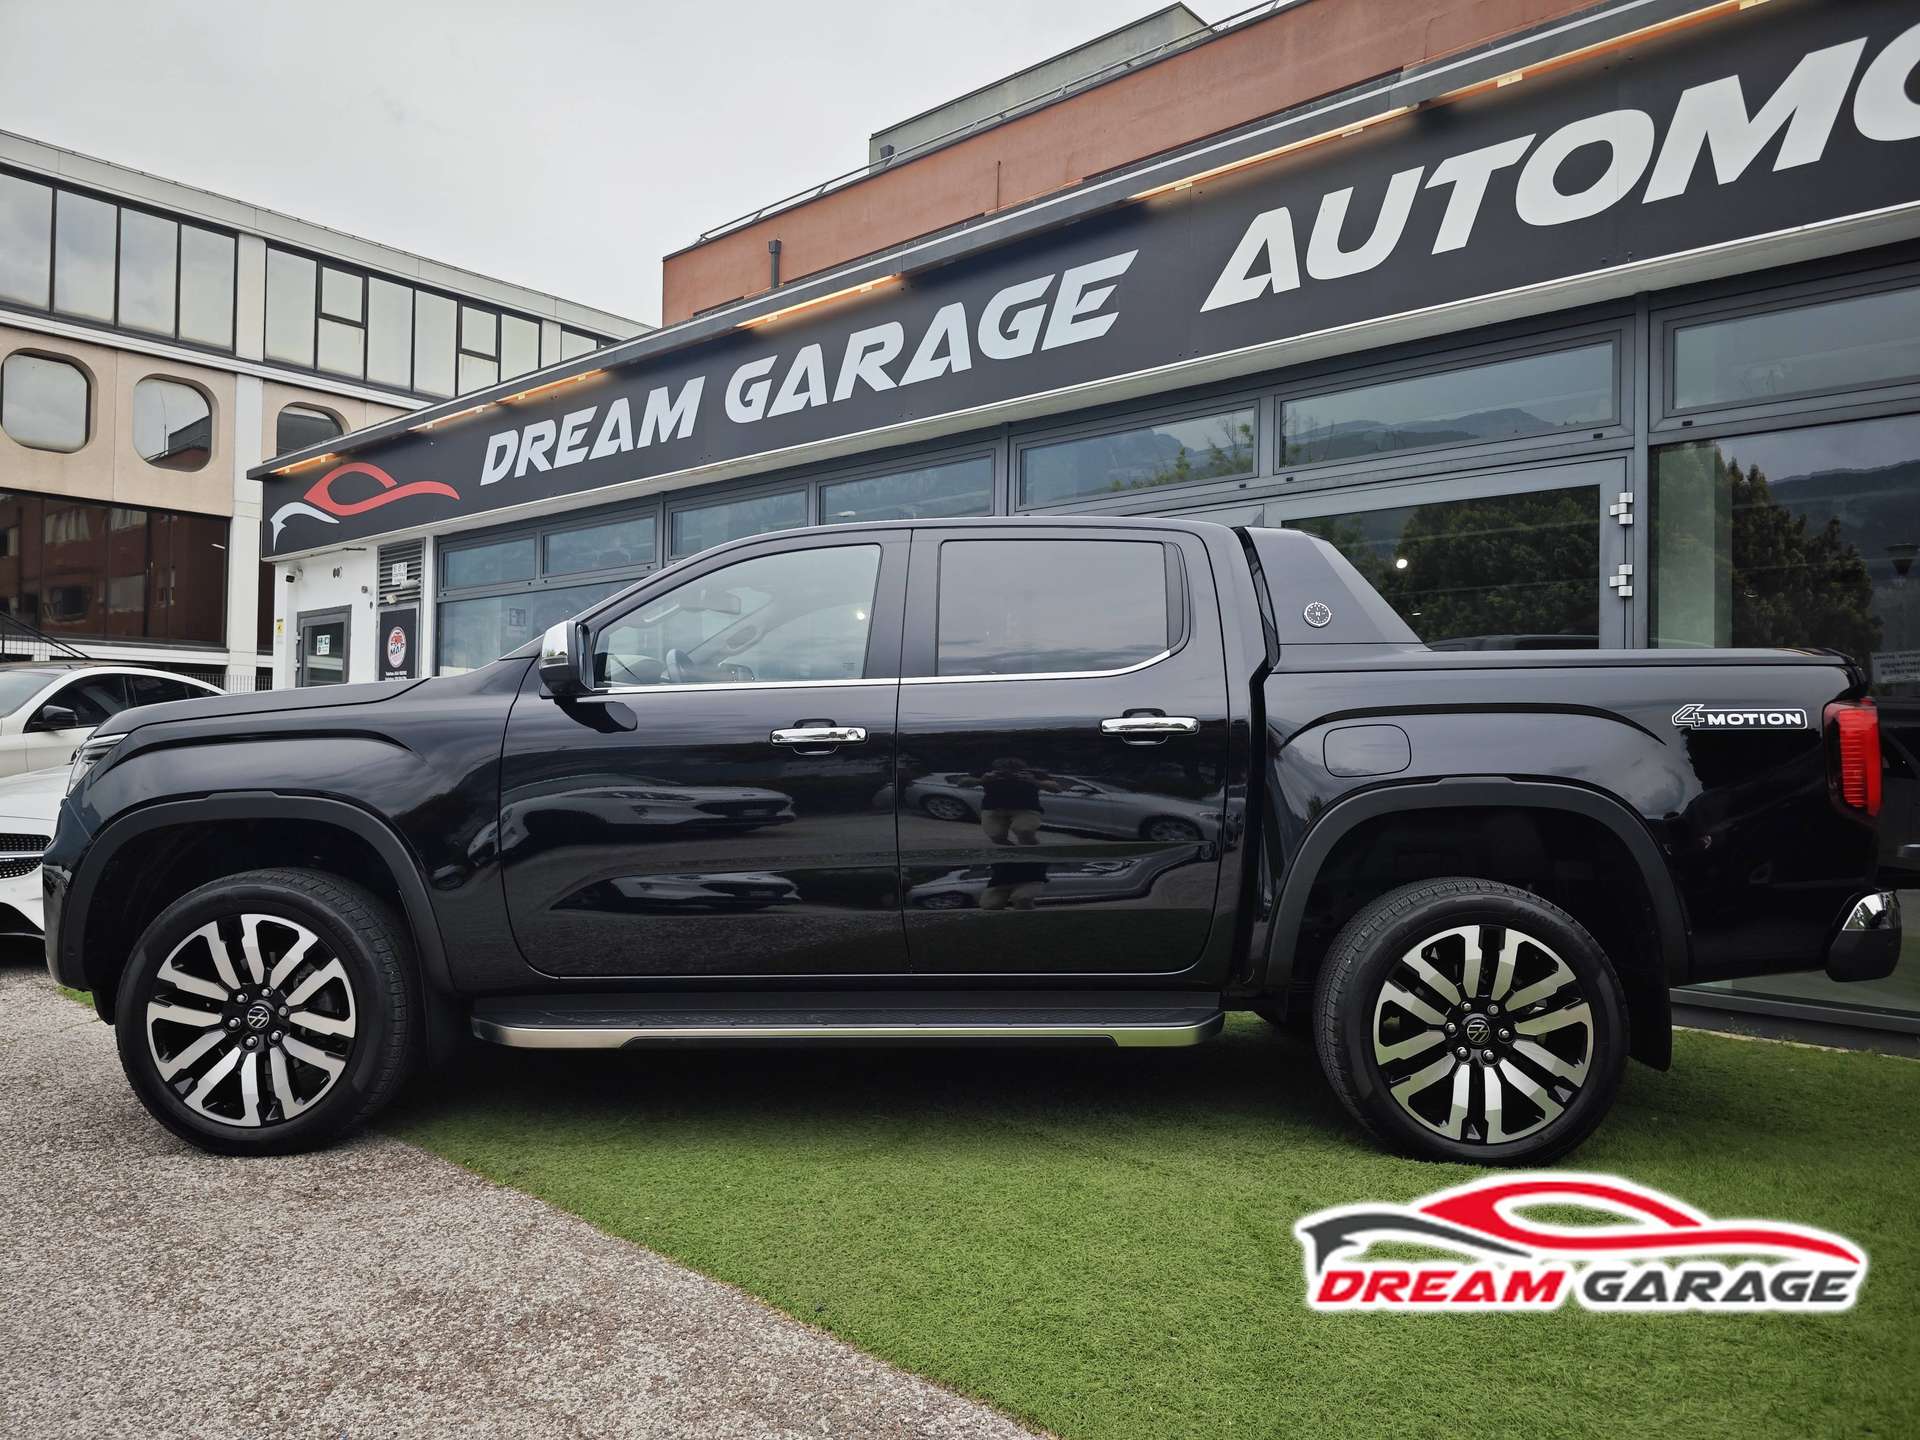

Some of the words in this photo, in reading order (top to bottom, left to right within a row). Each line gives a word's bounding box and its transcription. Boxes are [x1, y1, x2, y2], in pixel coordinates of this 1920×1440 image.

[480, 376, 706, 487] DREAM
[724, 249, 1139, 425] GARAGE
[1672, 704, 1807, 730] 4MOTION
